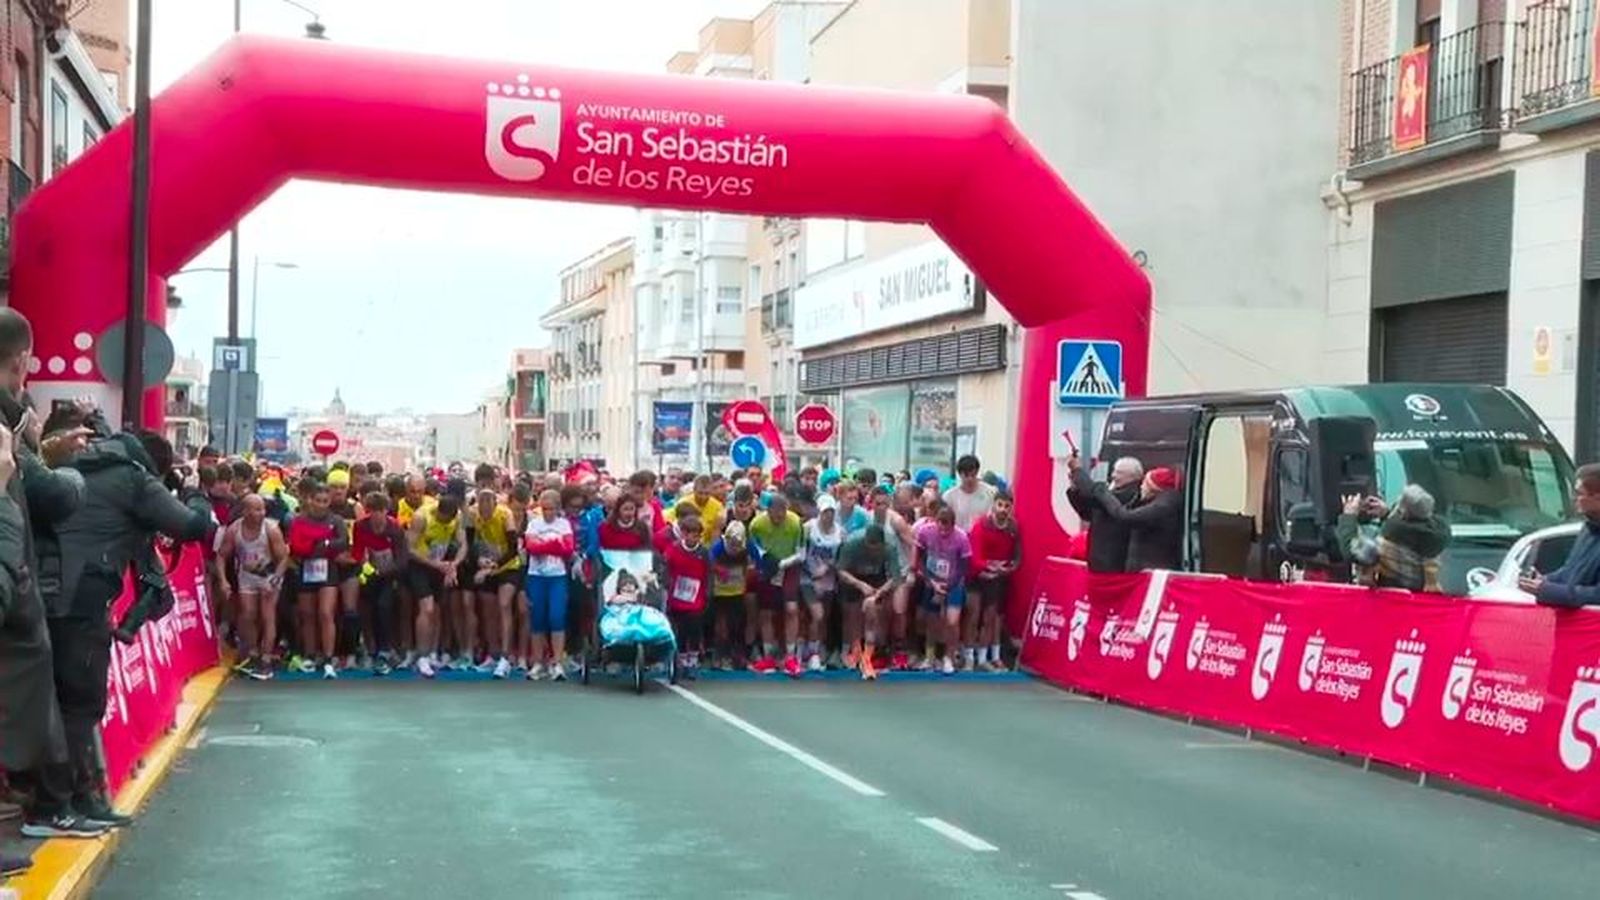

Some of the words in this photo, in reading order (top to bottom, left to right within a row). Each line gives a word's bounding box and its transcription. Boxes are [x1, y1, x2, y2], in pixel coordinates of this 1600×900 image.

[576, 103, 702, 126] AYUNTAMIENTO
[704, 113, 726, 128] DE
[576, 121, 633, 157] San
[641, 127, 788, 168] Sebastián
[572, 158, 613, 186] de
[617, 160, 660, 190] los
[665, 166, 755, 199] Reyes
[878, 272, 901, 311] SAN
[903, 256, 951, 303] MIGUEL
[800, 419, 831, 431] STOP
[1469, 679, 1493, 702] San
[1491, 682, 1545, 714] Sebastián
[1464, 702, 1482, 723] de
[1495, 708, 1529, 736] Reyes
